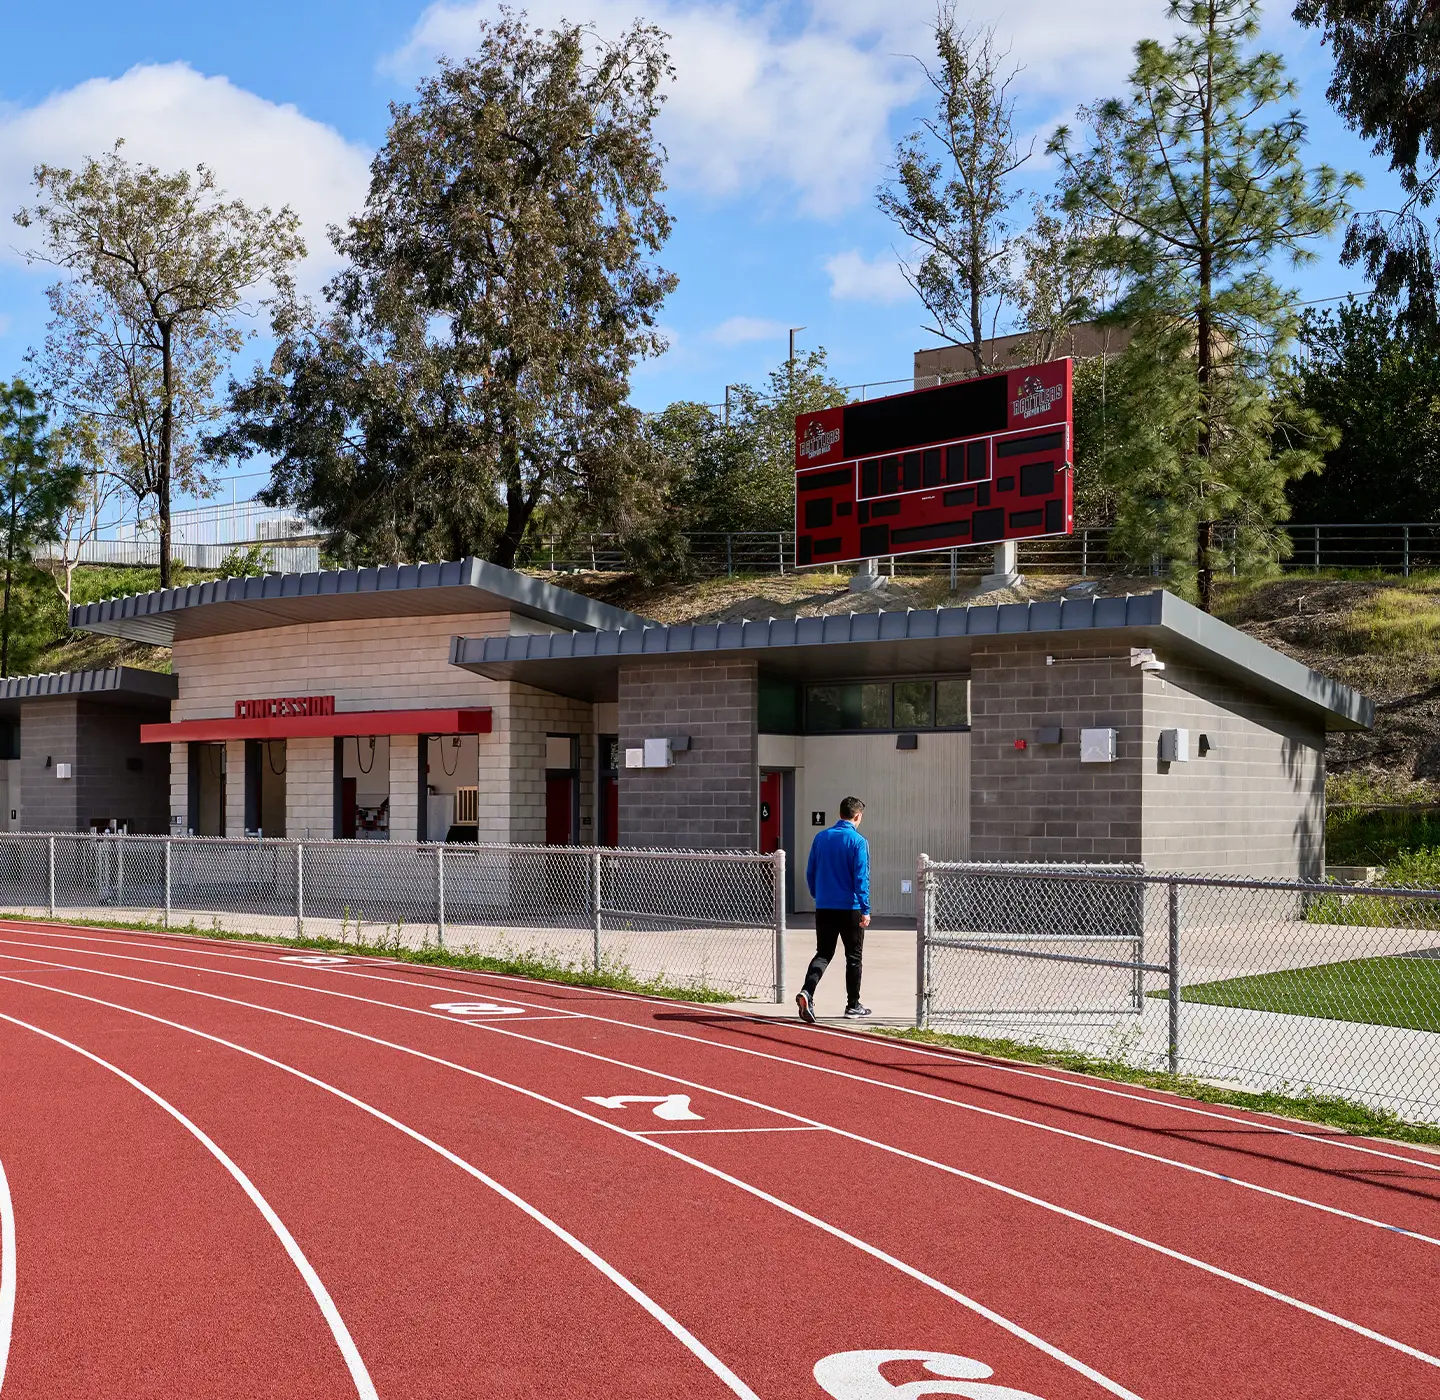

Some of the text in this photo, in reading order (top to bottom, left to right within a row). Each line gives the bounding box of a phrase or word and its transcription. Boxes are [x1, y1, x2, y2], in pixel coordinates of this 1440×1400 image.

[1013, 384, 1062, 416] RATTLERS
[235, 696, 335, 719] CONCESSION
[278, 955, 349, 964] 9
[429, 1002, 526, 1015] 8
[581, 1093, 706, 1121] 7
[813, 1349, 1046, 1400] 6
